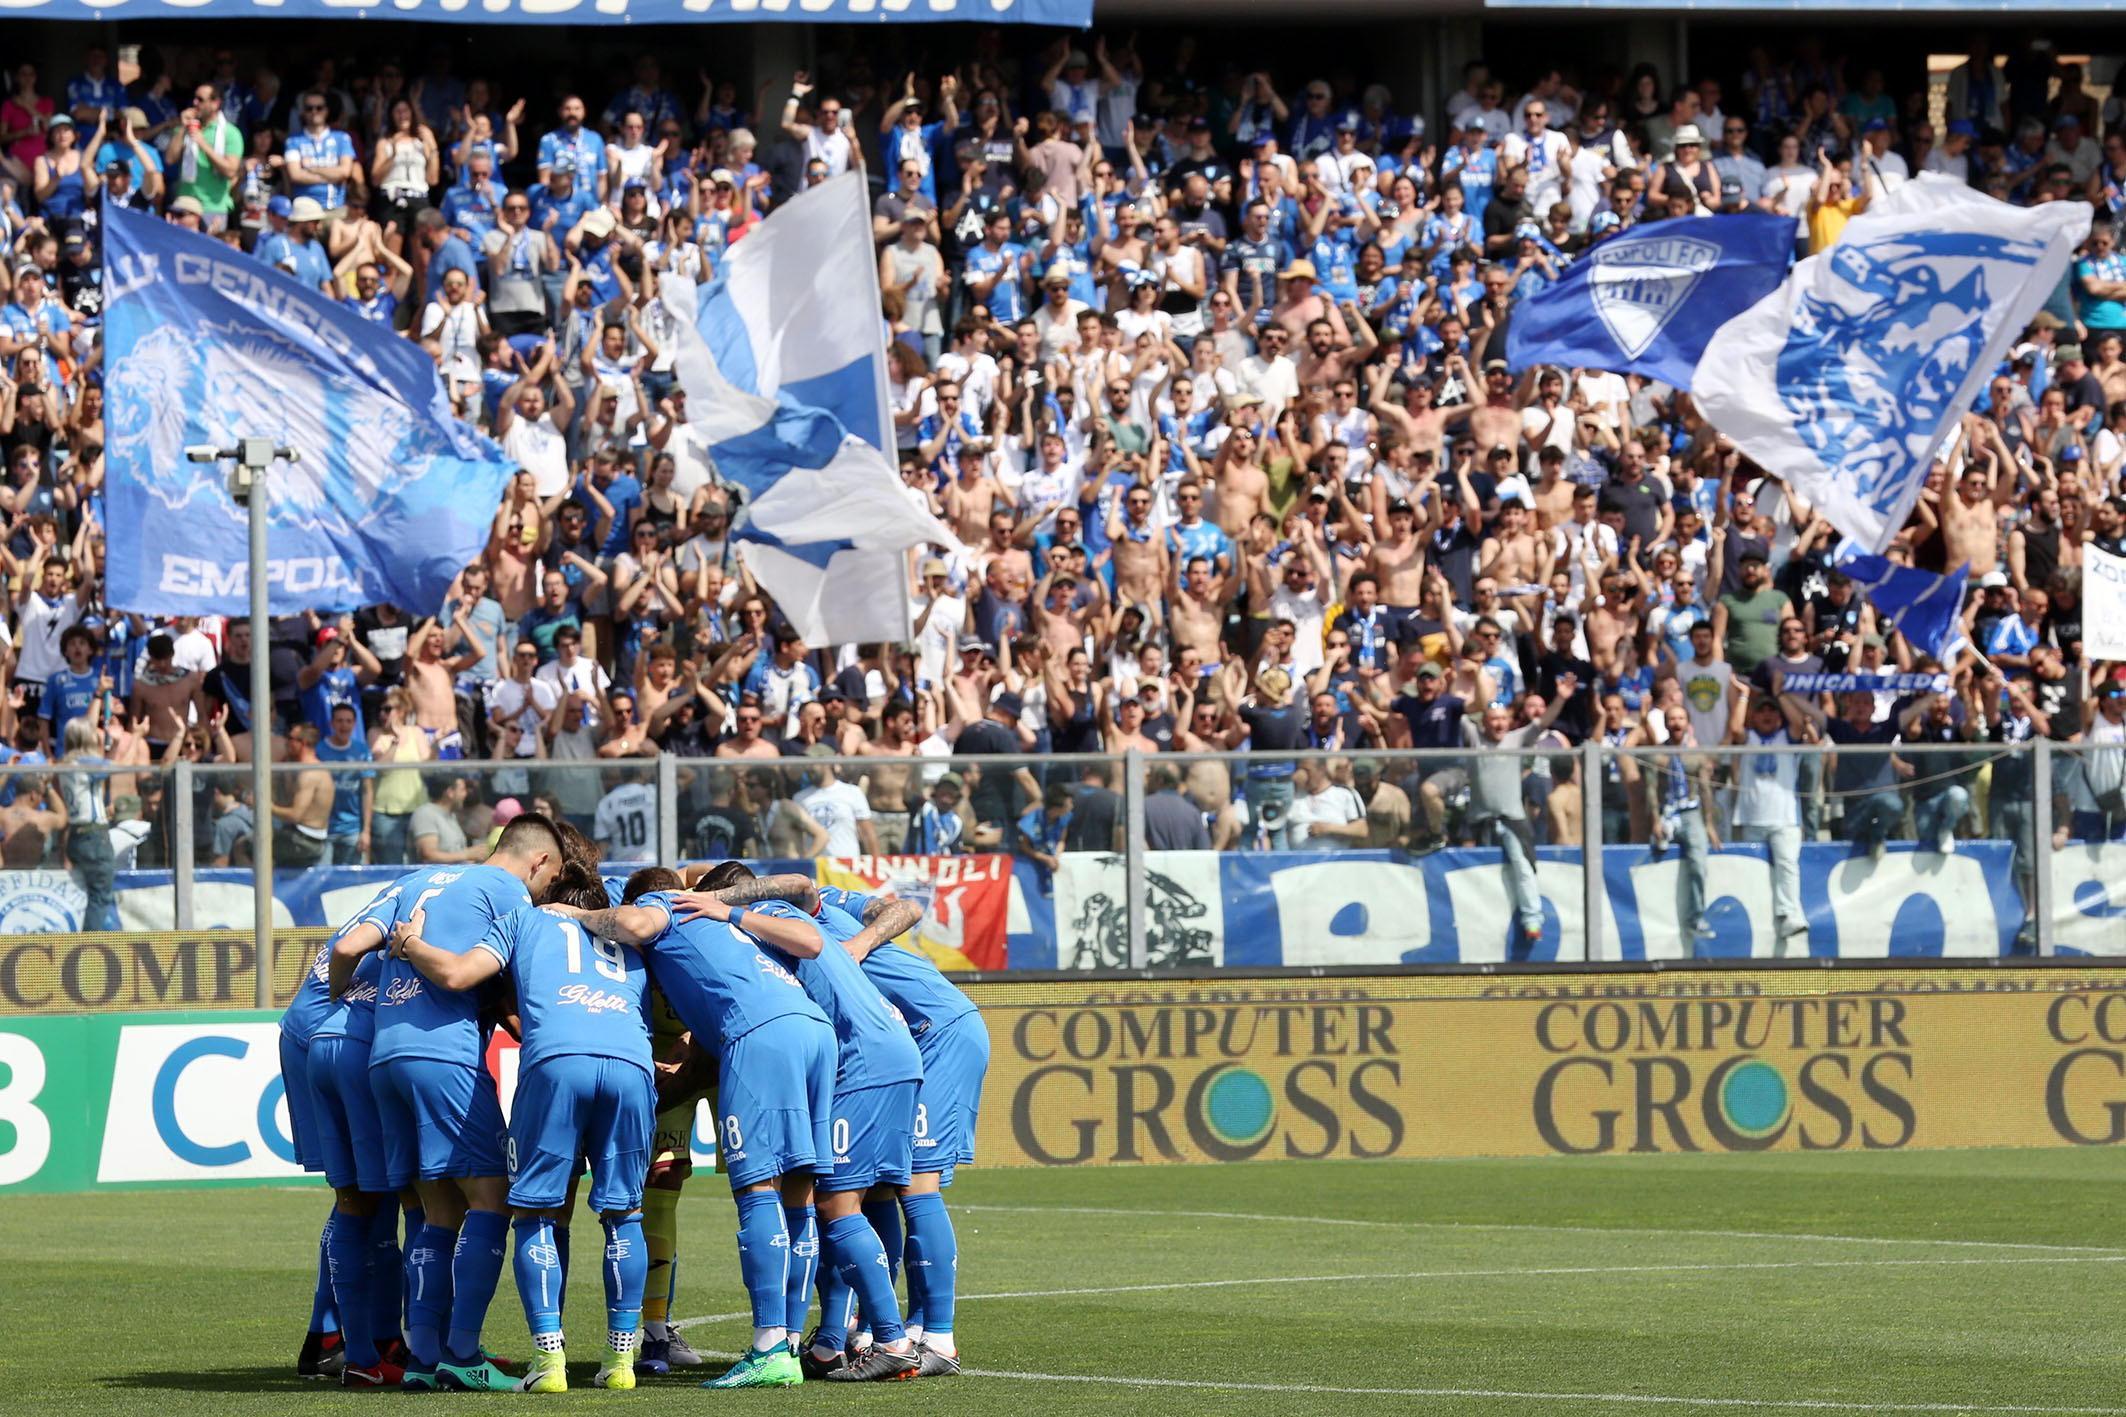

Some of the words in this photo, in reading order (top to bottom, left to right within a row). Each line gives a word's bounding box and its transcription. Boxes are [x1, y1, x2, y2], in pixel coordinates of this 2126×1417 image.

[159, 554, 363, 597] EMPOL
[617, 810, 646, 847] 10
[558, 922, 628, 983] 19
[557, 984, 628, 1013] Giletti
[1535, 997, 1911, 1053] COMPUTER
[1012, 1004, 1400, 1061] COMPUTER
[1011, 1059, 1404, 1166] GROSS
[1533, 1051, 1916, 1155] GROSS
[2046, 1048, 2126, 1145] G
[507, 1136, 519, 1173] 9
[832, 1118, 849, 1154] 0
